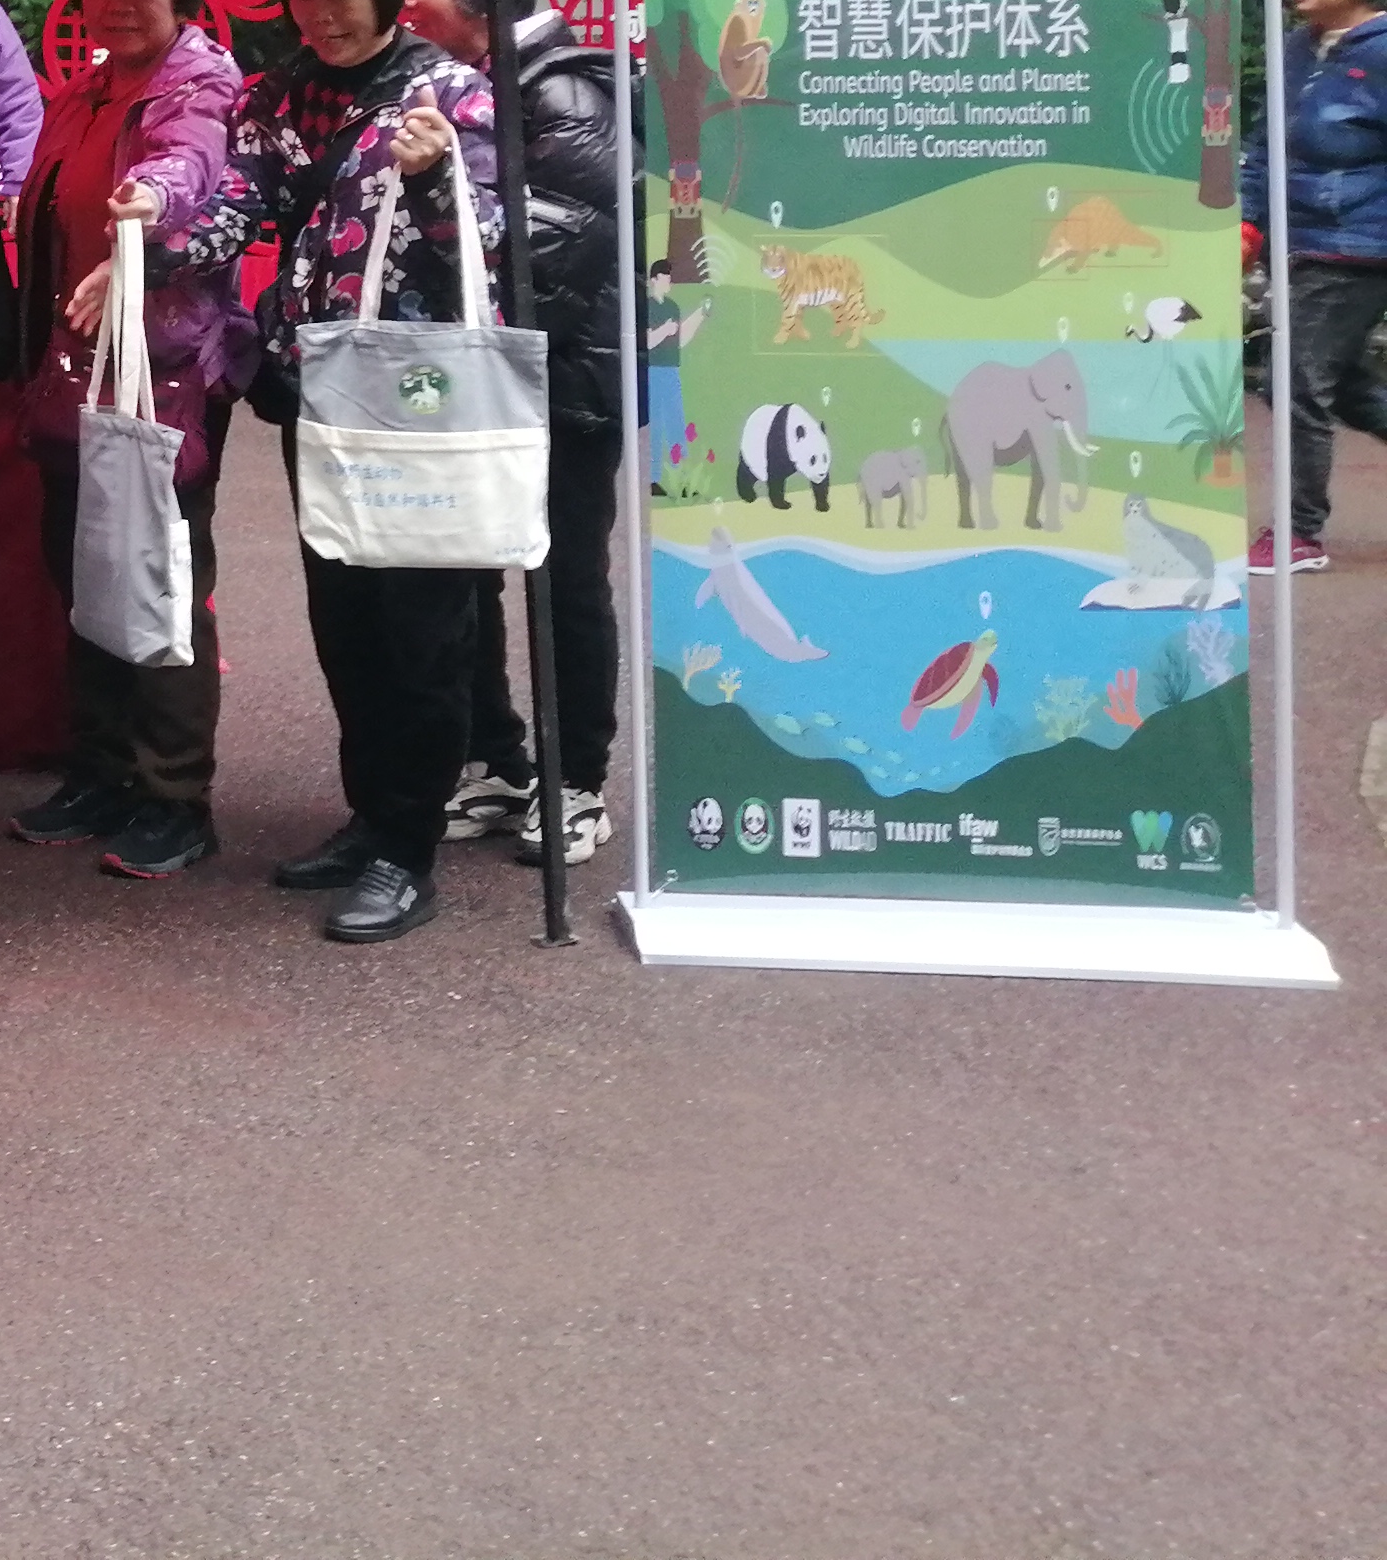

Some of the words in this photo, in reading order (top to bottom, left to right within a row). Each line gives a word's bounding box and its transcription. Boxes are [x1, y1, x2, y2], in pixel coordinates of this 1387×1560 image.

[799, 69, 904, 100] Connecting
[909, 68, 974, 98] People
[979, 68, 1016, 92] and
[1022, 67, 1091, 92] Planet:
[799, 102, 889, 132] Exploring
[894, 101, 958, 132] Digital
[965, 101, 1067, 126] Innovation
[1072, 100, 1091, 125] in
[844, 133, 918, 158] Wildlife
[922, 133, 1048, 158] Conservation
[884, 821, 953, 843] TRAFFIC
